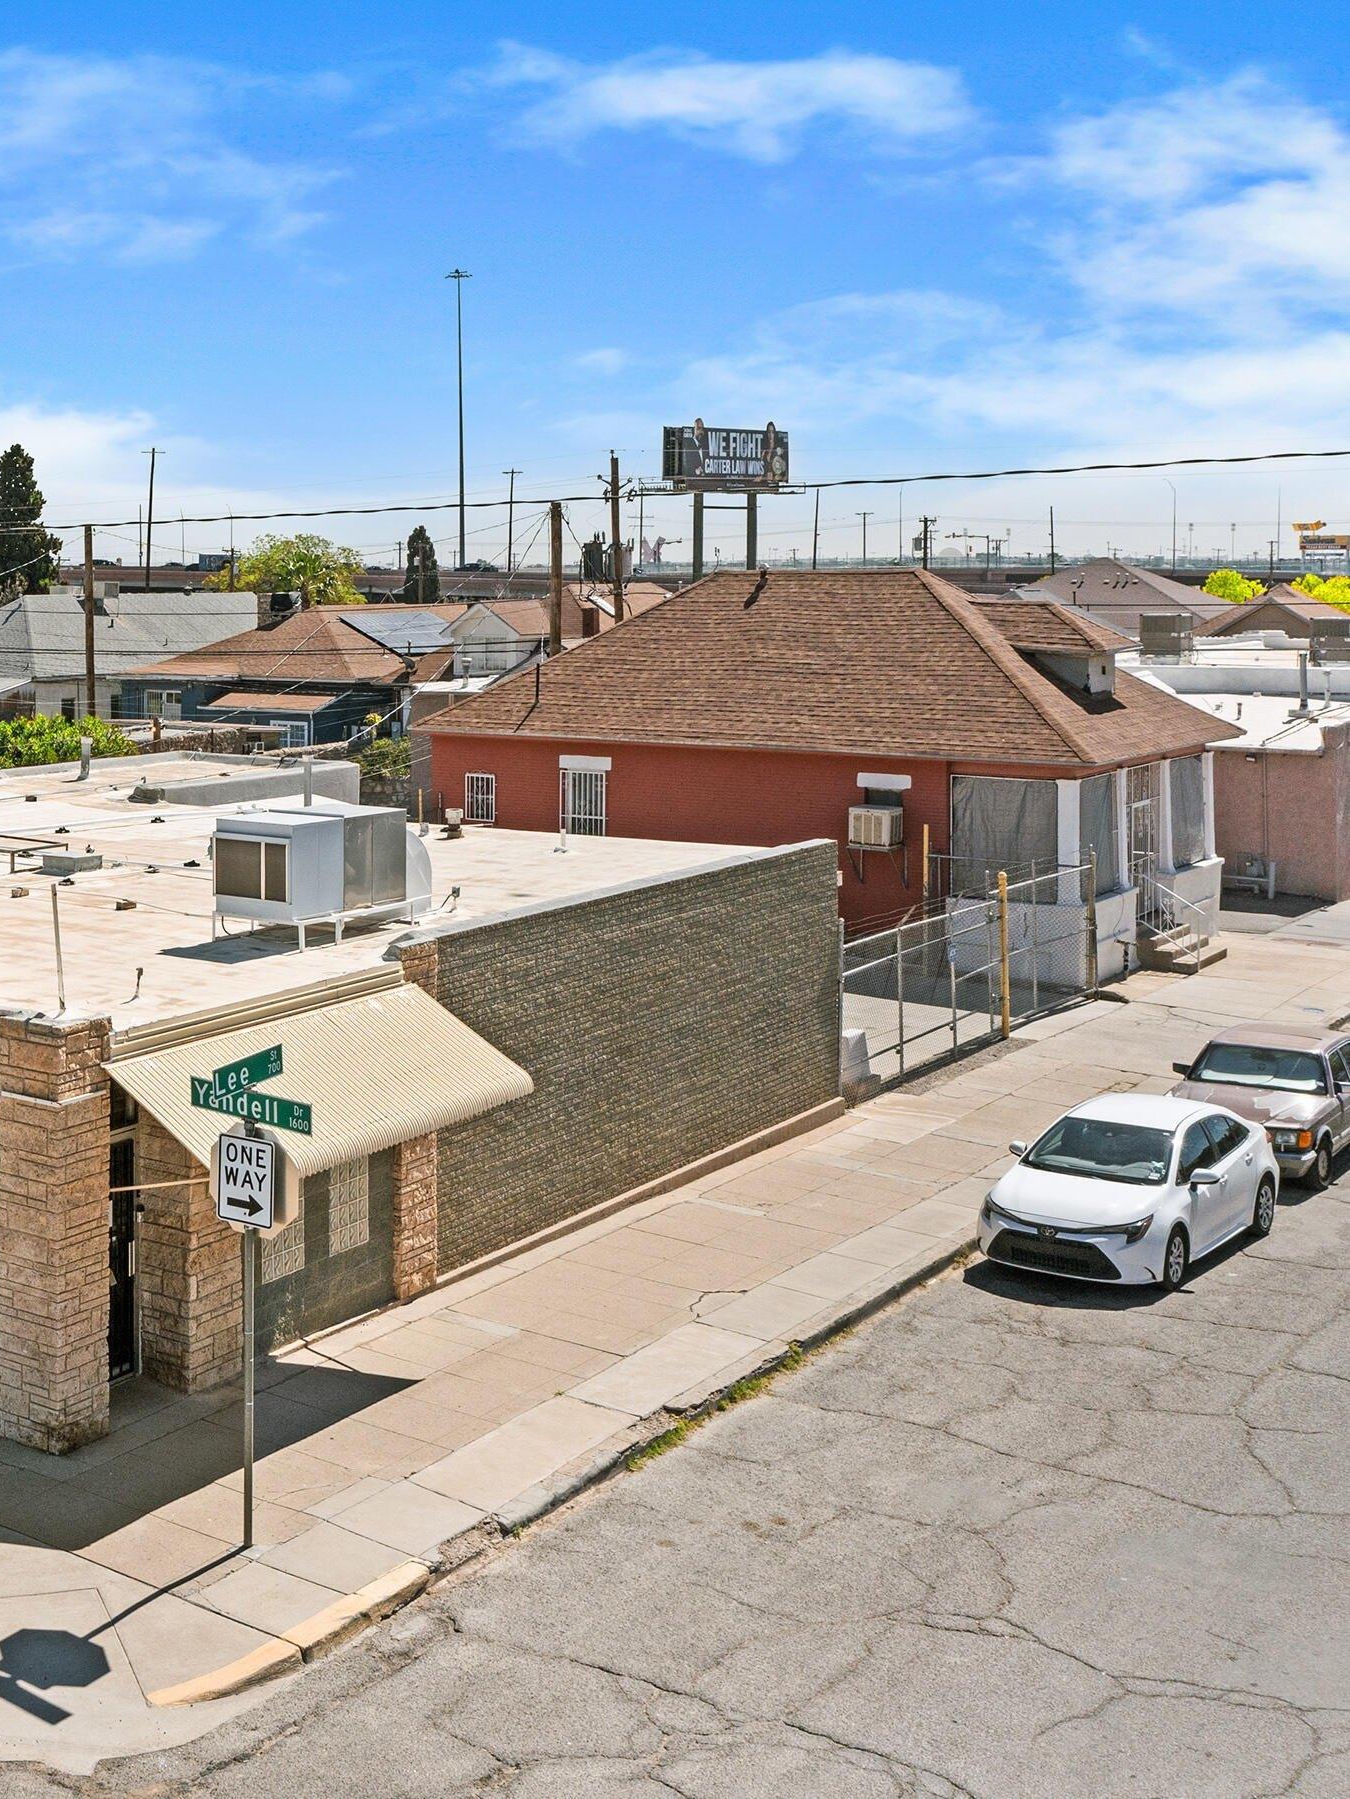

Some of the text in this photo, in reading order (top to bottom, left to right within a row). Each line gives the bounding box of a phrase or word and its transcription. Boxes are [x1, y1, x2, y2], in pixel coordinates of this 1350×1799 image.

[707, 431, 727, 457] WE
[729, 432, 763, 459] FIGHT
[704, 459, 765, 475] CARTER LAW WINS
[214, 1050, 278, 1097] Lee St
[267, 1061, 281, 1074] 700
[194, 1081, 303, 1124] Yandell Dr
[289, 1117, 310, 1132] 1600
[225, 1142, 267, 1169] ONE
[224, 1165, 267, 1192] WAY
